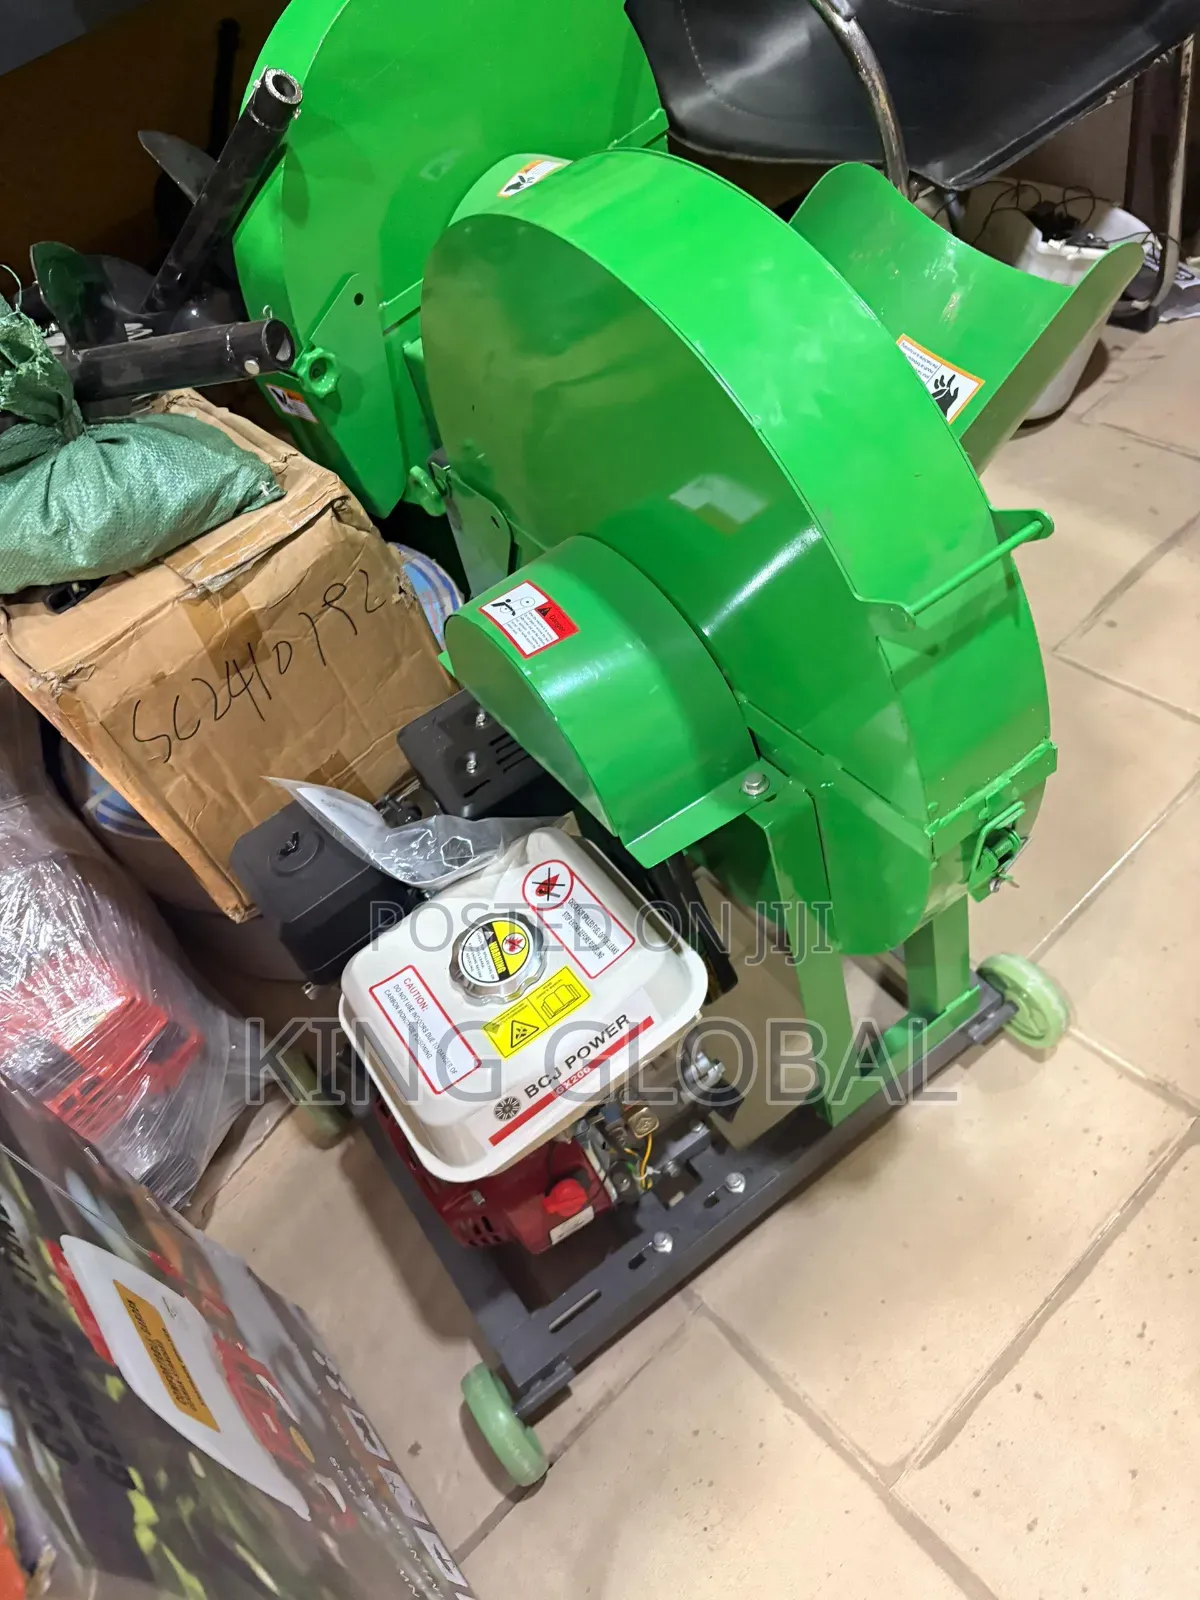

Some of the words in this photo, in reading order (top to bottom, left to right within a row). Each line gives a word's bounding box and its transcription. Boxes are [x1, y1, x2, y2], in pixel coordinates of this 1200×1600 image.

[488, 941, 506, 973] WARNING
[383, 989, 400, 1009] CARBON
[402, 977, 429, 1011] CAUTION:
[393, 984, 401, 992] DO
[398, 991, 408, 1002] NOT
[404, 1001, 414, 1012] USE
[410, 1011, 428, 1033] INDOORS
[424, 1031, 435, 1042] DUE
[431, 1041, 439, 1049] TO
[449, 1066, 457, 1074] OF
[524, 1066, 562, 1099] BCJ
[564, 1014, 630, 1070] POWER
